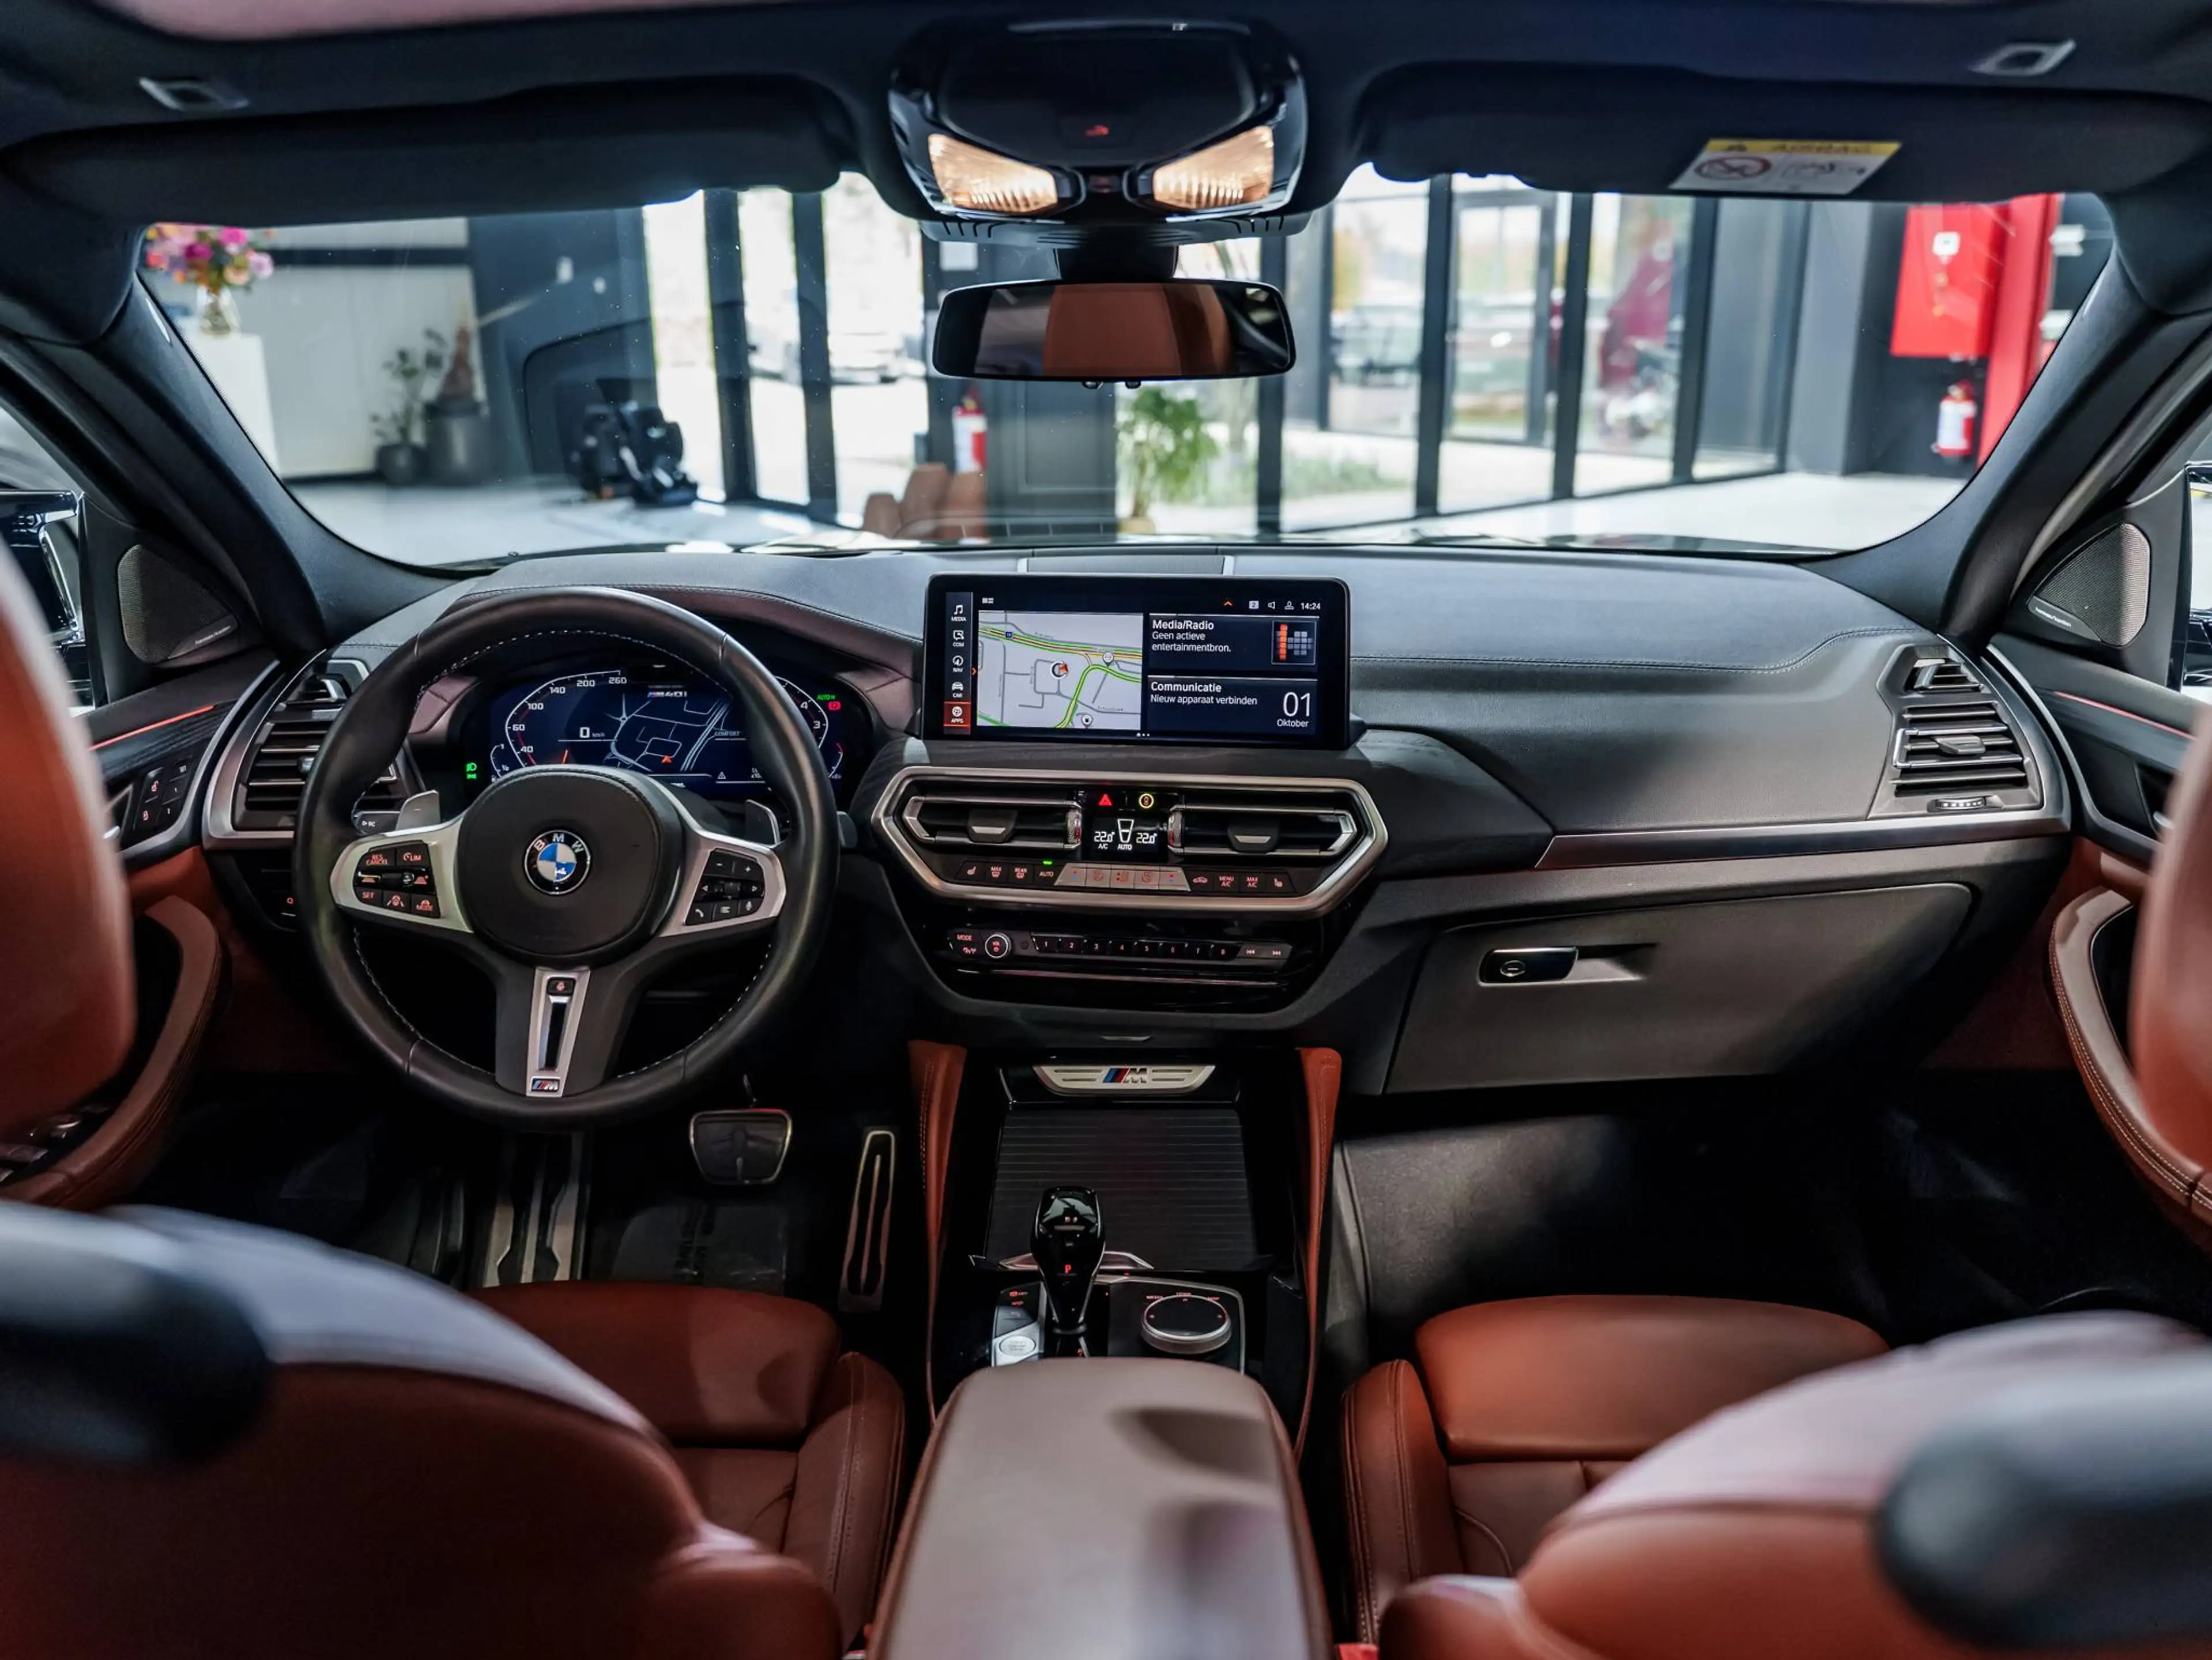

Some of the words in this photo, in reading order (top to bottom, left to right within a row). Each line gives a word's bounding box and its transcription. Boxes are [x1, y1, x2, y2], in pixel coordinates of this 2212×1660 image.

[1152, 620, 1214, 630] Media/Radio
[1152, 631, 1174, 640] Geen
[1176, 632, 1205, 640] actieve
[1152, 643, 1231, 652] entertainmentbron.
[1151, 681, 1222, 692] Communicatie
[1151, 695, 1175, 703] Nieuw
[1177, 695, 1214, 705] apparaat
[1216, 696, 1257, 705] verbinden
[1283, 692, 1311, 716] 01
[813, 720, 821, 729] 3
[1276, 719, 1309, 727] Oktober
[579, 726, 590, 738] 0
[533, 833, 584, 853] BMW
[1064, 1264, 1072, 1273] P
